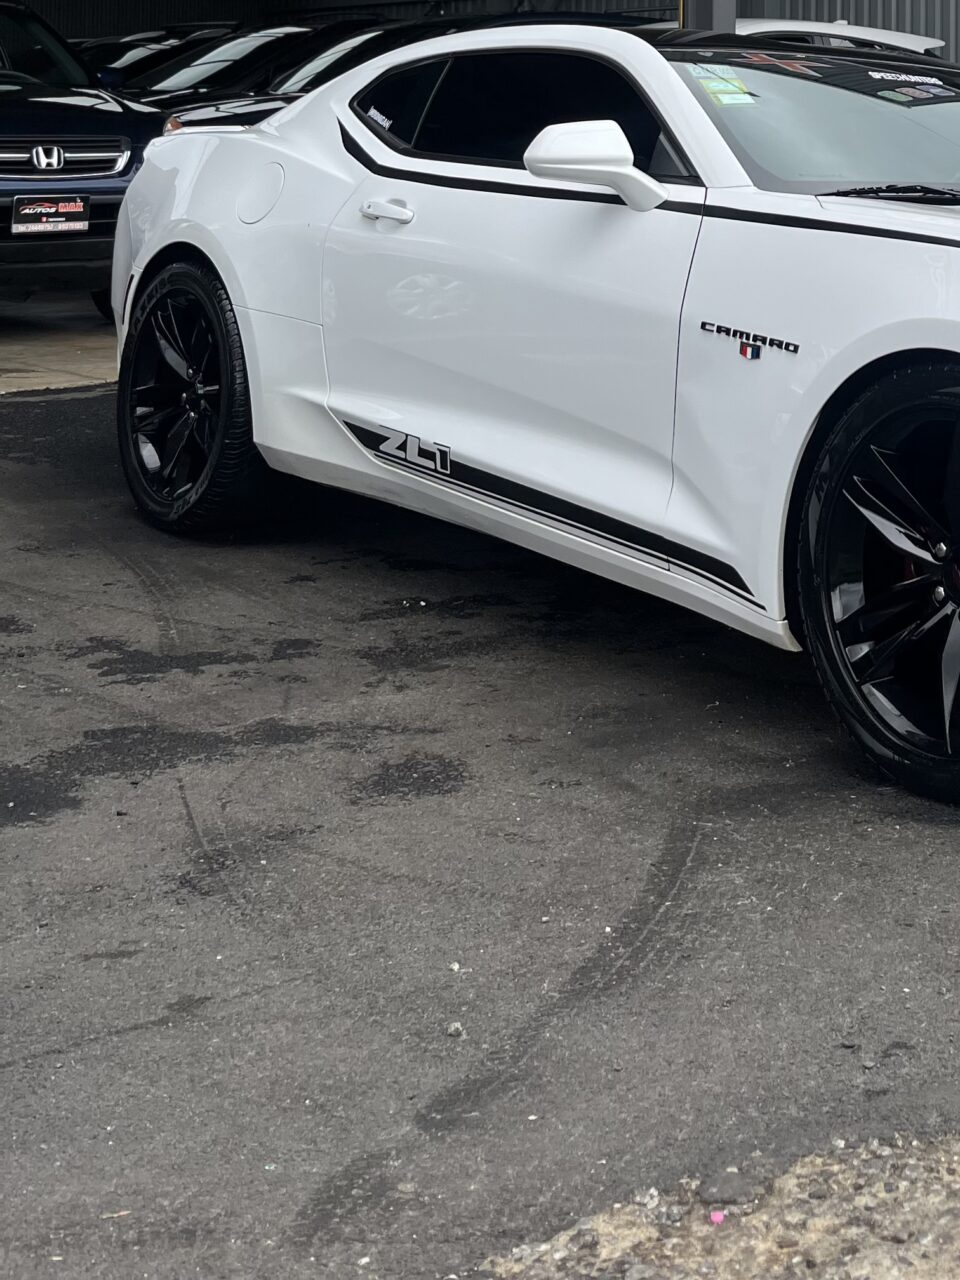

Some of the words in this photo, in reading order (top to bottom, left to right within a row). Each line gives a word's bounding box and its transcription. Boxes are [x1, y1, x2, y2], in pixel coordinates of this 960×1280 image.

[58, 202, 84, 212] MAX
[700, 321, 800, 354] CAMARO
[379, 424, 451, 474] ZL1
